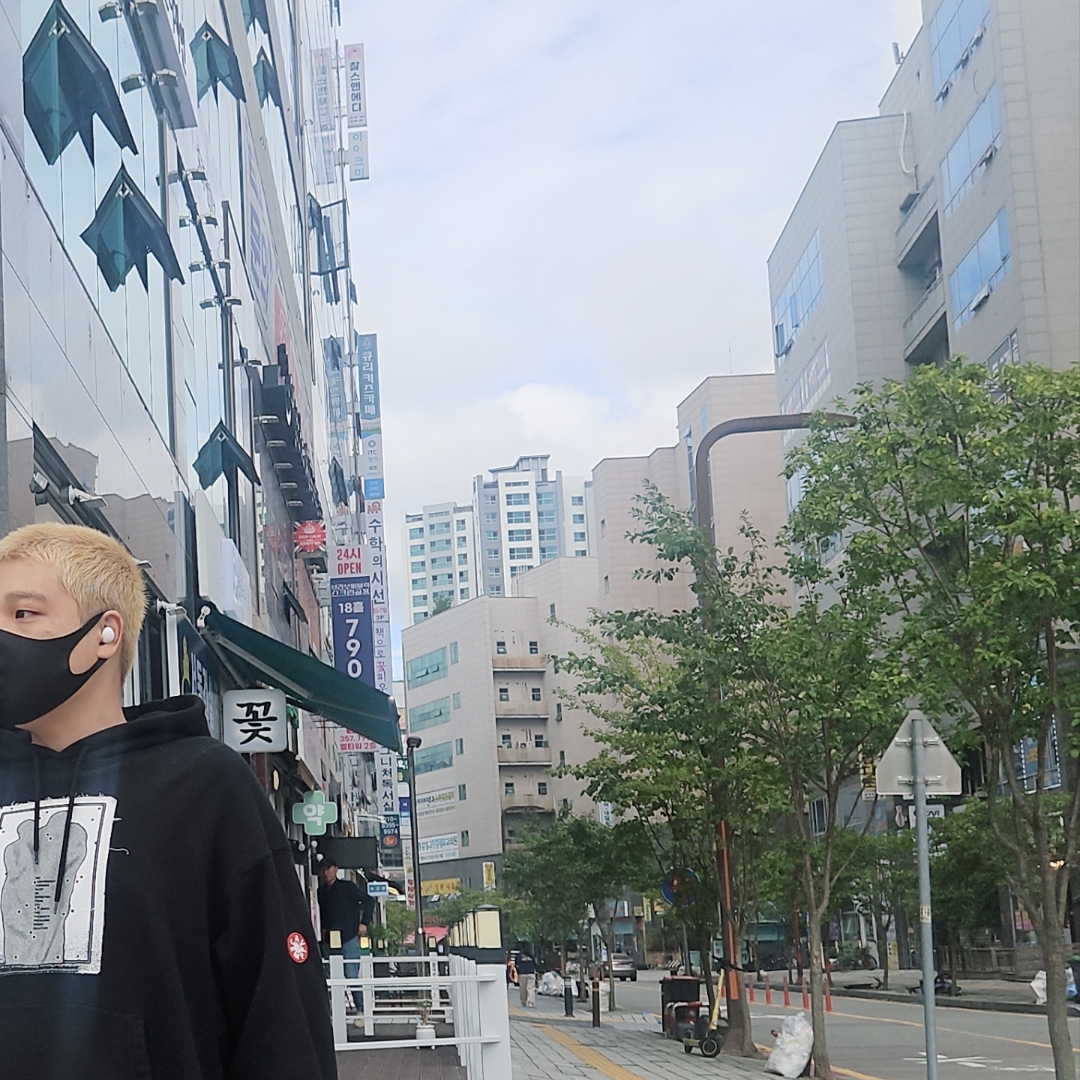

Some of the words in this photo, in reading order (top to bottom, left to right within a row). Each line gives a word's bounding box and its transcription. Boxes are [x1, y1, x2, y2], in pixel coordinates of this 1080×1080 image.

[349, 61, 362, 113] 찰스앤에디
[362, 351, 376, 416] 큐리키즈카페
[336, 547, 361, 560] 24시
[337, 562, 362, 575] OPEN
[368, 518, 385, 605] 수학의시선
[231, 701, 279, 746] 꽃
[380, 748, 394, 813] 니처독서실
[302, 803, 325, 827] 약
